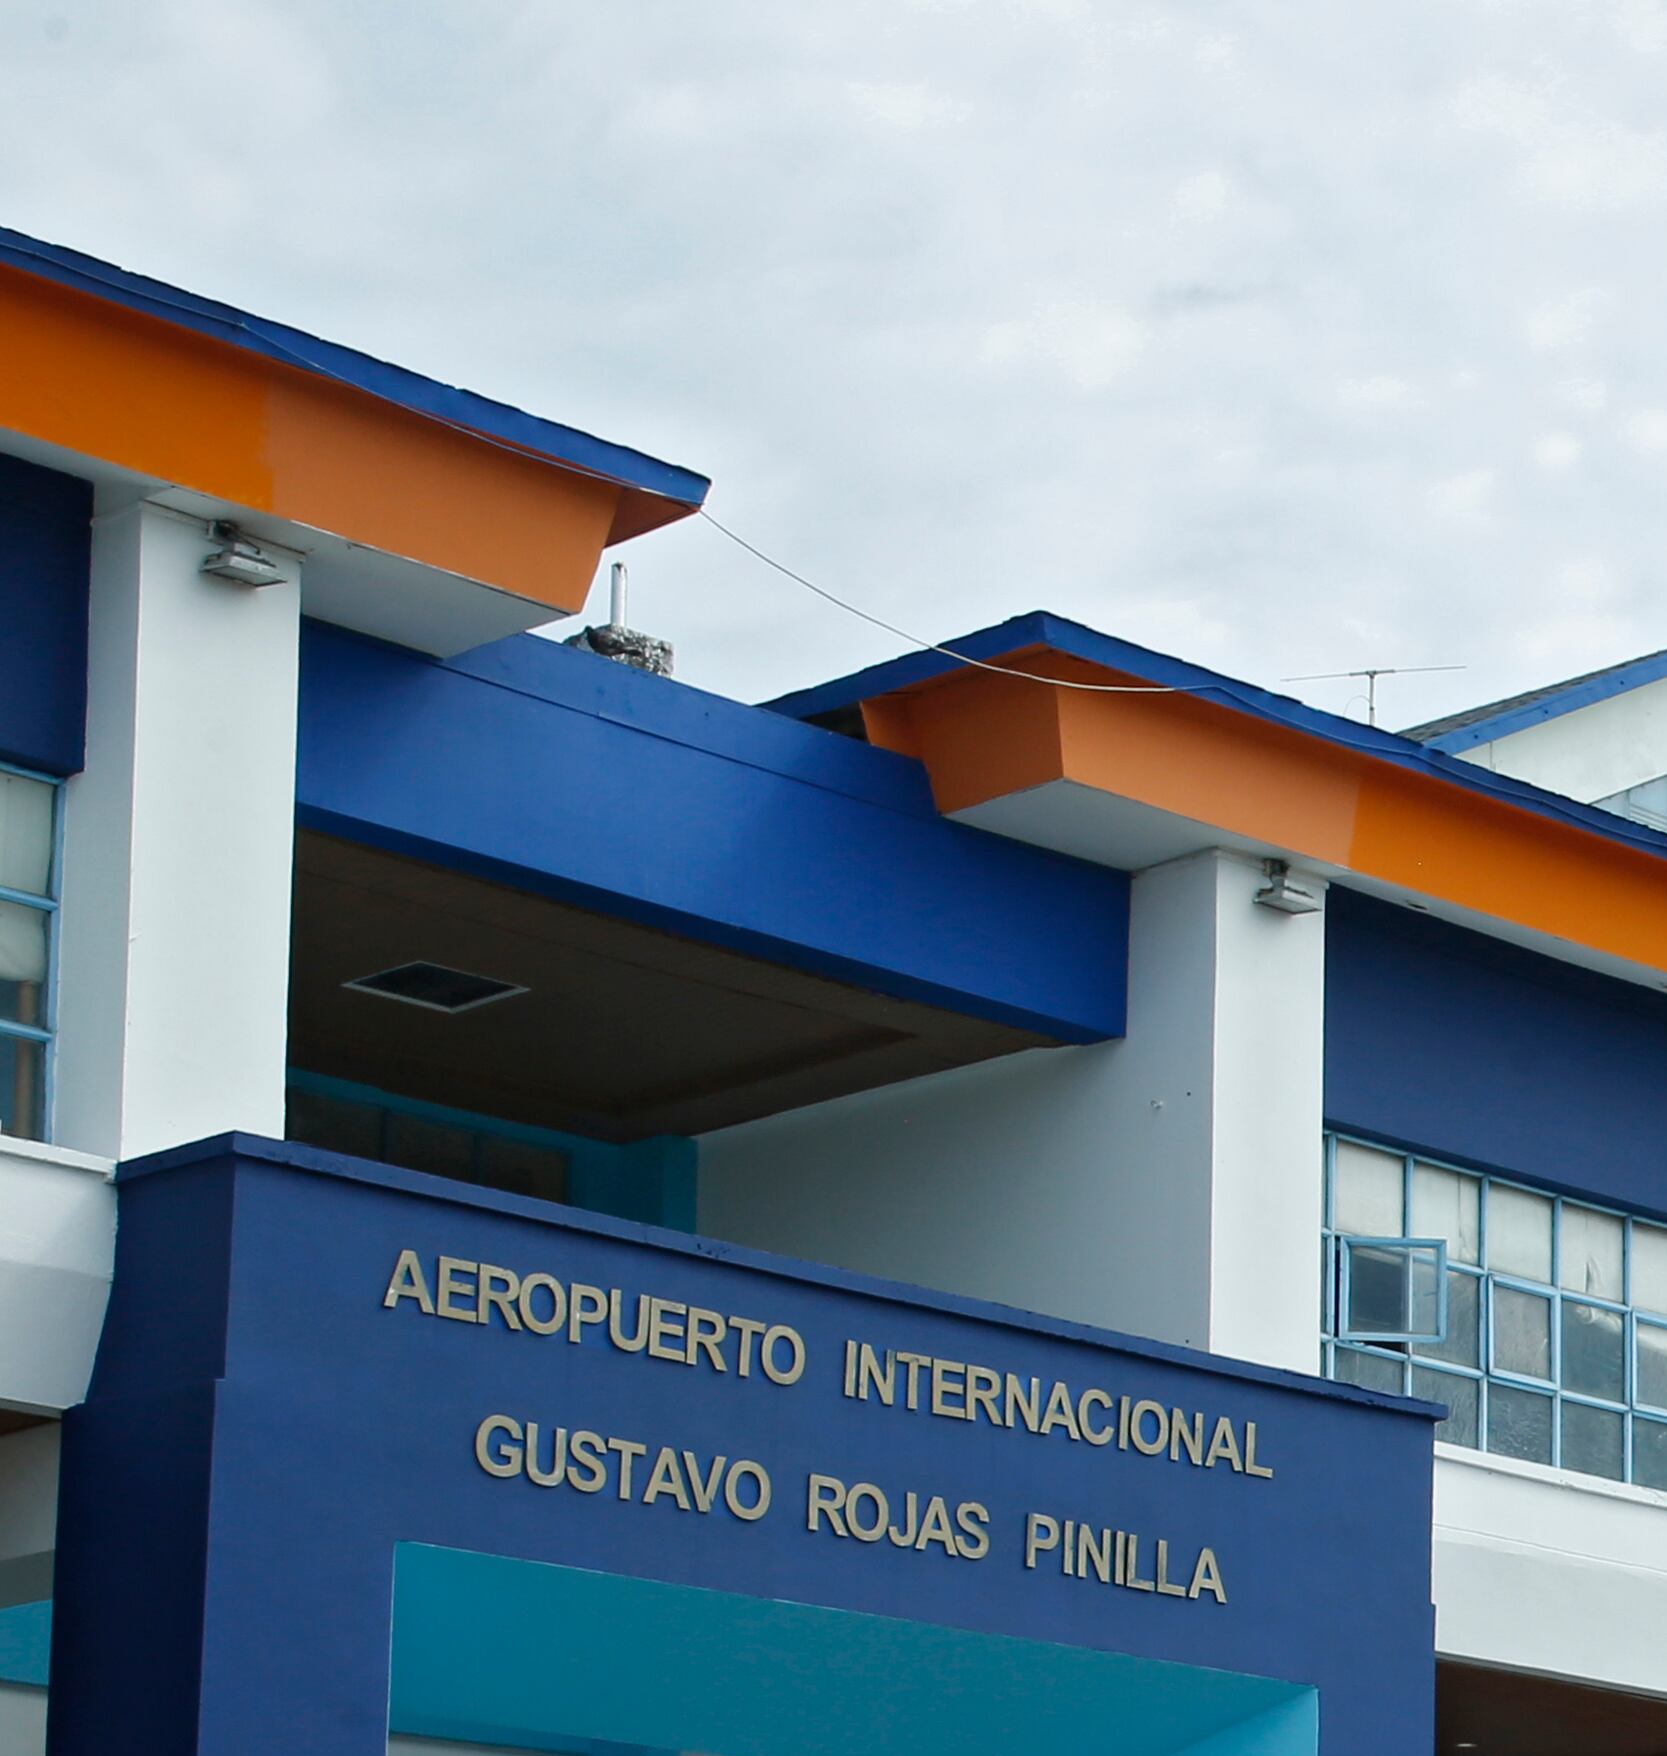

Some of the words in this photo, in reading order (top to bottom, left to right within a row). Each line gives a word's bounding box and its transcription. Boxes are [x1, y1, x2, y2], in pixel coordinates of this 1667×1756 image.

[384, 1249, 805, 1386] AEROPUERTO
[843, 1339, 1273, 1479] INTERNACIONAL
[475, 1414, 772, 1522] GUSTAVO
[807, 1474, 990, 1560] ROJAS
[1025, 1514, 1227, 1603] PINILLA
